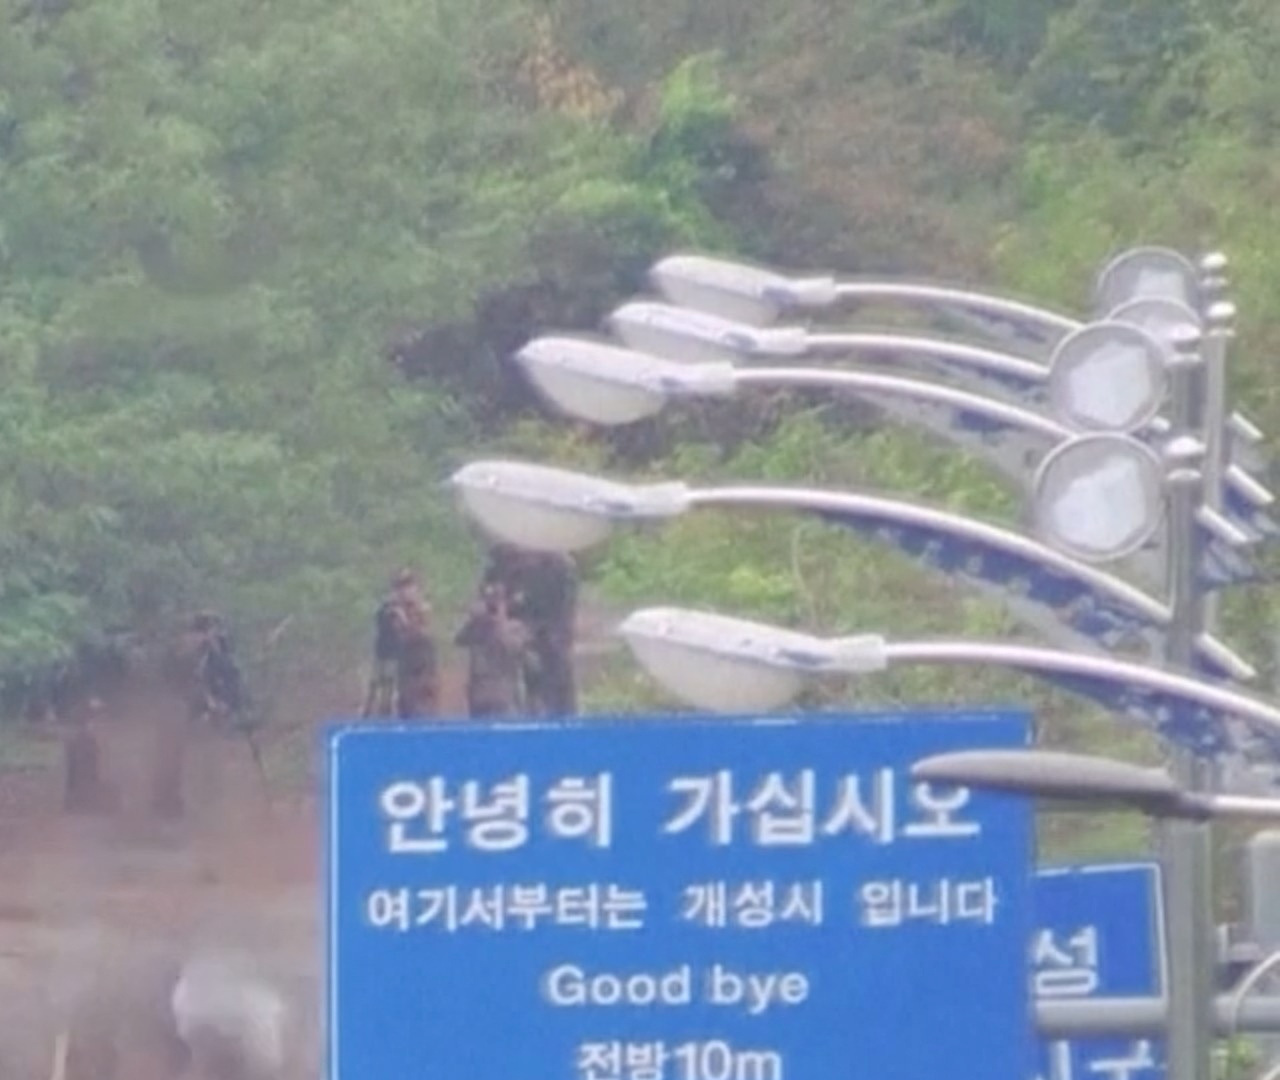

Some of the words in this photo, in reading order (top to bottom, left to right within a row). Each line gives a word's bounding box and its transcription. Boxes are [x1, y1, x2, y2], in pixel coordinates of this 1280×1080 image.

[380, 770, 613, 852] 안녕히
[664, 767, 983, 845] 가십시오
[366, 882, 647, 933] 여기서부터는
[682, 879, 823, 928] 개성시
[861, 876, 998, 927] 입니다
[547, 963, 691, 1004] Good
[712, 963, 809, 1015] bye
